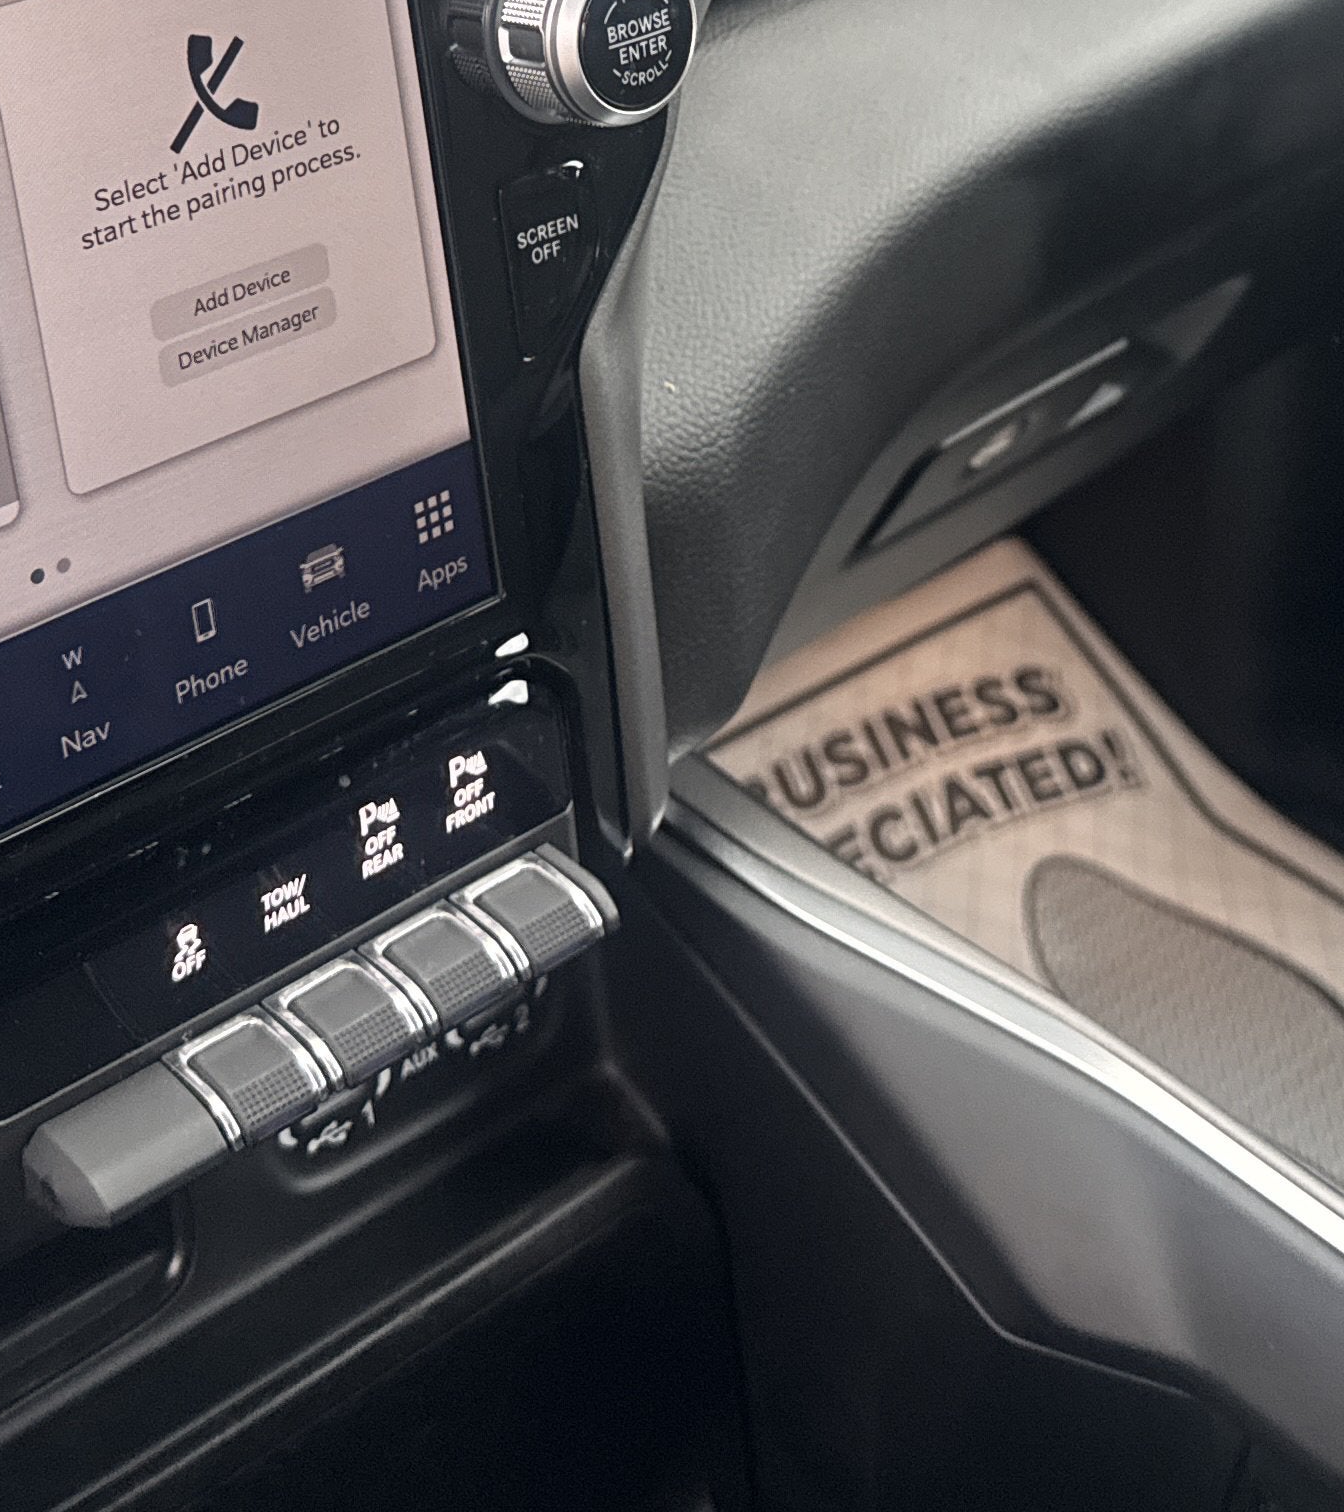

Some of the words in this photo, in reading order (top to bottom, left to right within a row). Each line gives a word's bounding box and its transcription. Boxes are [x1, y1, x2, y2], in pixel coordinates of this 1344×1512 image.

[606, 8, 671, 45] BROWSE
[619, 35, 669, 66] ENTER
[621, 59, 670, 87] SCROLL
[94, 171, 170, 213] Select
[174, 151, 227, 186] 'Add
[231, 121, 313, 168] Device'
[319, 117, 341, 140] to
[81, 215, 138, 251] start
[142, 199, 182, 231] the
[186, 173, 268, 221] pairing
[272, 144, 362, 194] process.
[517, 214, 580, 251] SCREEN
[531, 241, 562, 266] OFF
[194, 289, 230, 317] Add
[232, 267, 292, 302] Device
[177, 334, 240, 371] Device
[242, 304, 321, 347] Manager
[417, 555, 469, 592] Apps
[290, 599, 371, 648] Vehicle
[61, 646, 83, 670] W
[175, 658, 249, 704] Phone
[61, 720, 111, 759] Nav
[746, 664, 1060, 811] USINESS
[445, 790, 497, 834] FRONT
[453, 777, 485, 808] OFF
[364, 824, 397, 856] OFF
[361, 842, 404, 880] REAR
[260, 873, 307, 912] TOW/
[263, 895, 311, 934] HAUL
[171, 948, 207, 983] OFF
[400, 1041, 440, 1081] AUX
